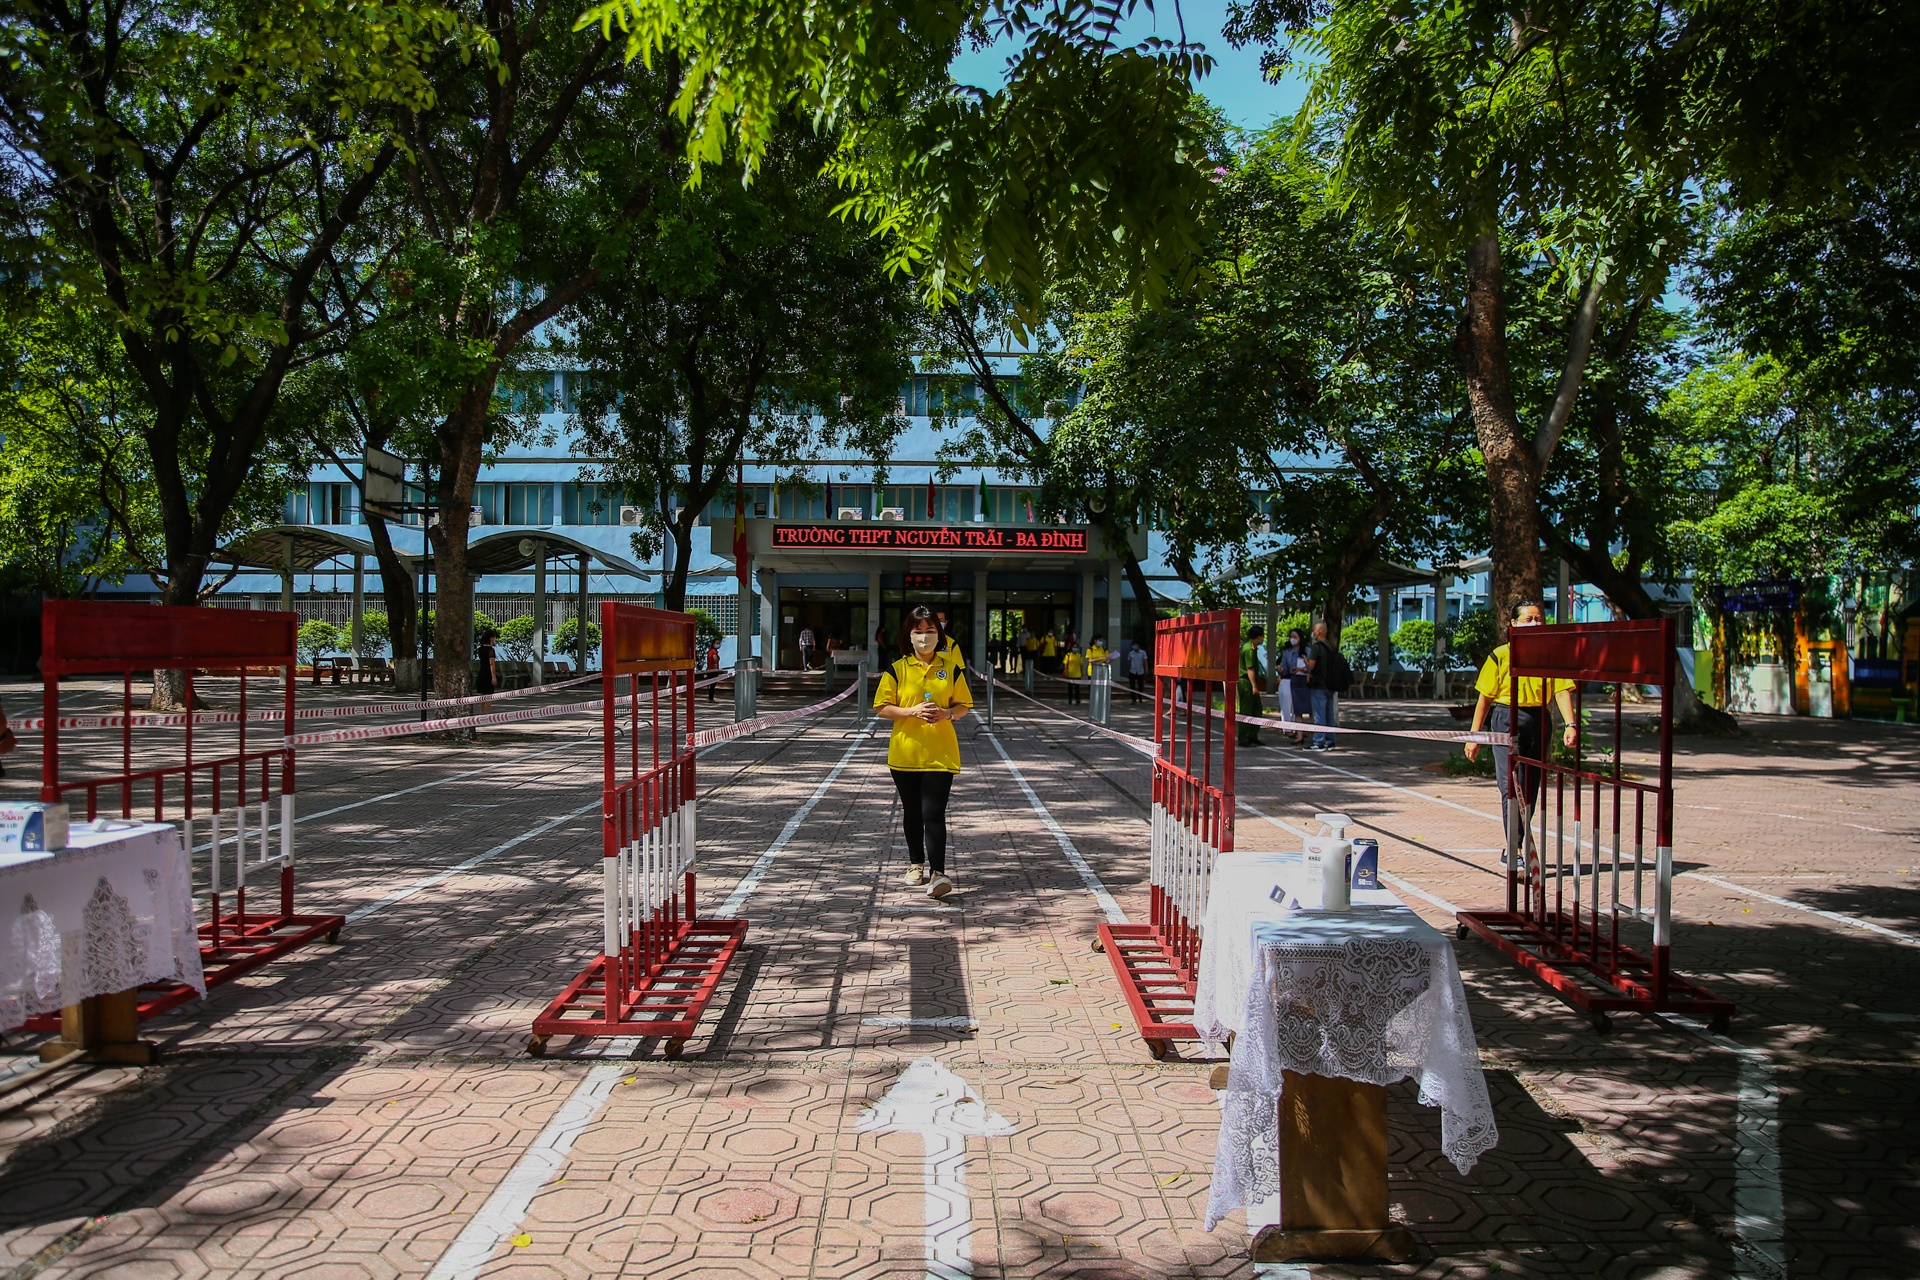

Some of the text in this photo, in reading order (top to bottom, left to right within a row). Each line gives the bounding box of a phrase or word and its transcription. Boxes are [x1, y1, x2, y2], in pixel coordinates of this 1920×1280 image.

[776, 526, 845, 544] TRƯỜNG
[848, 529, 892, 544] THPT
[894, 527, 962, 545] NGUYỄN
[964, 529, 1004, 546] TRÃI
[1015, 532, 1038, 547] BA
[1040, 530, 1084, 548] ĐÌNH
